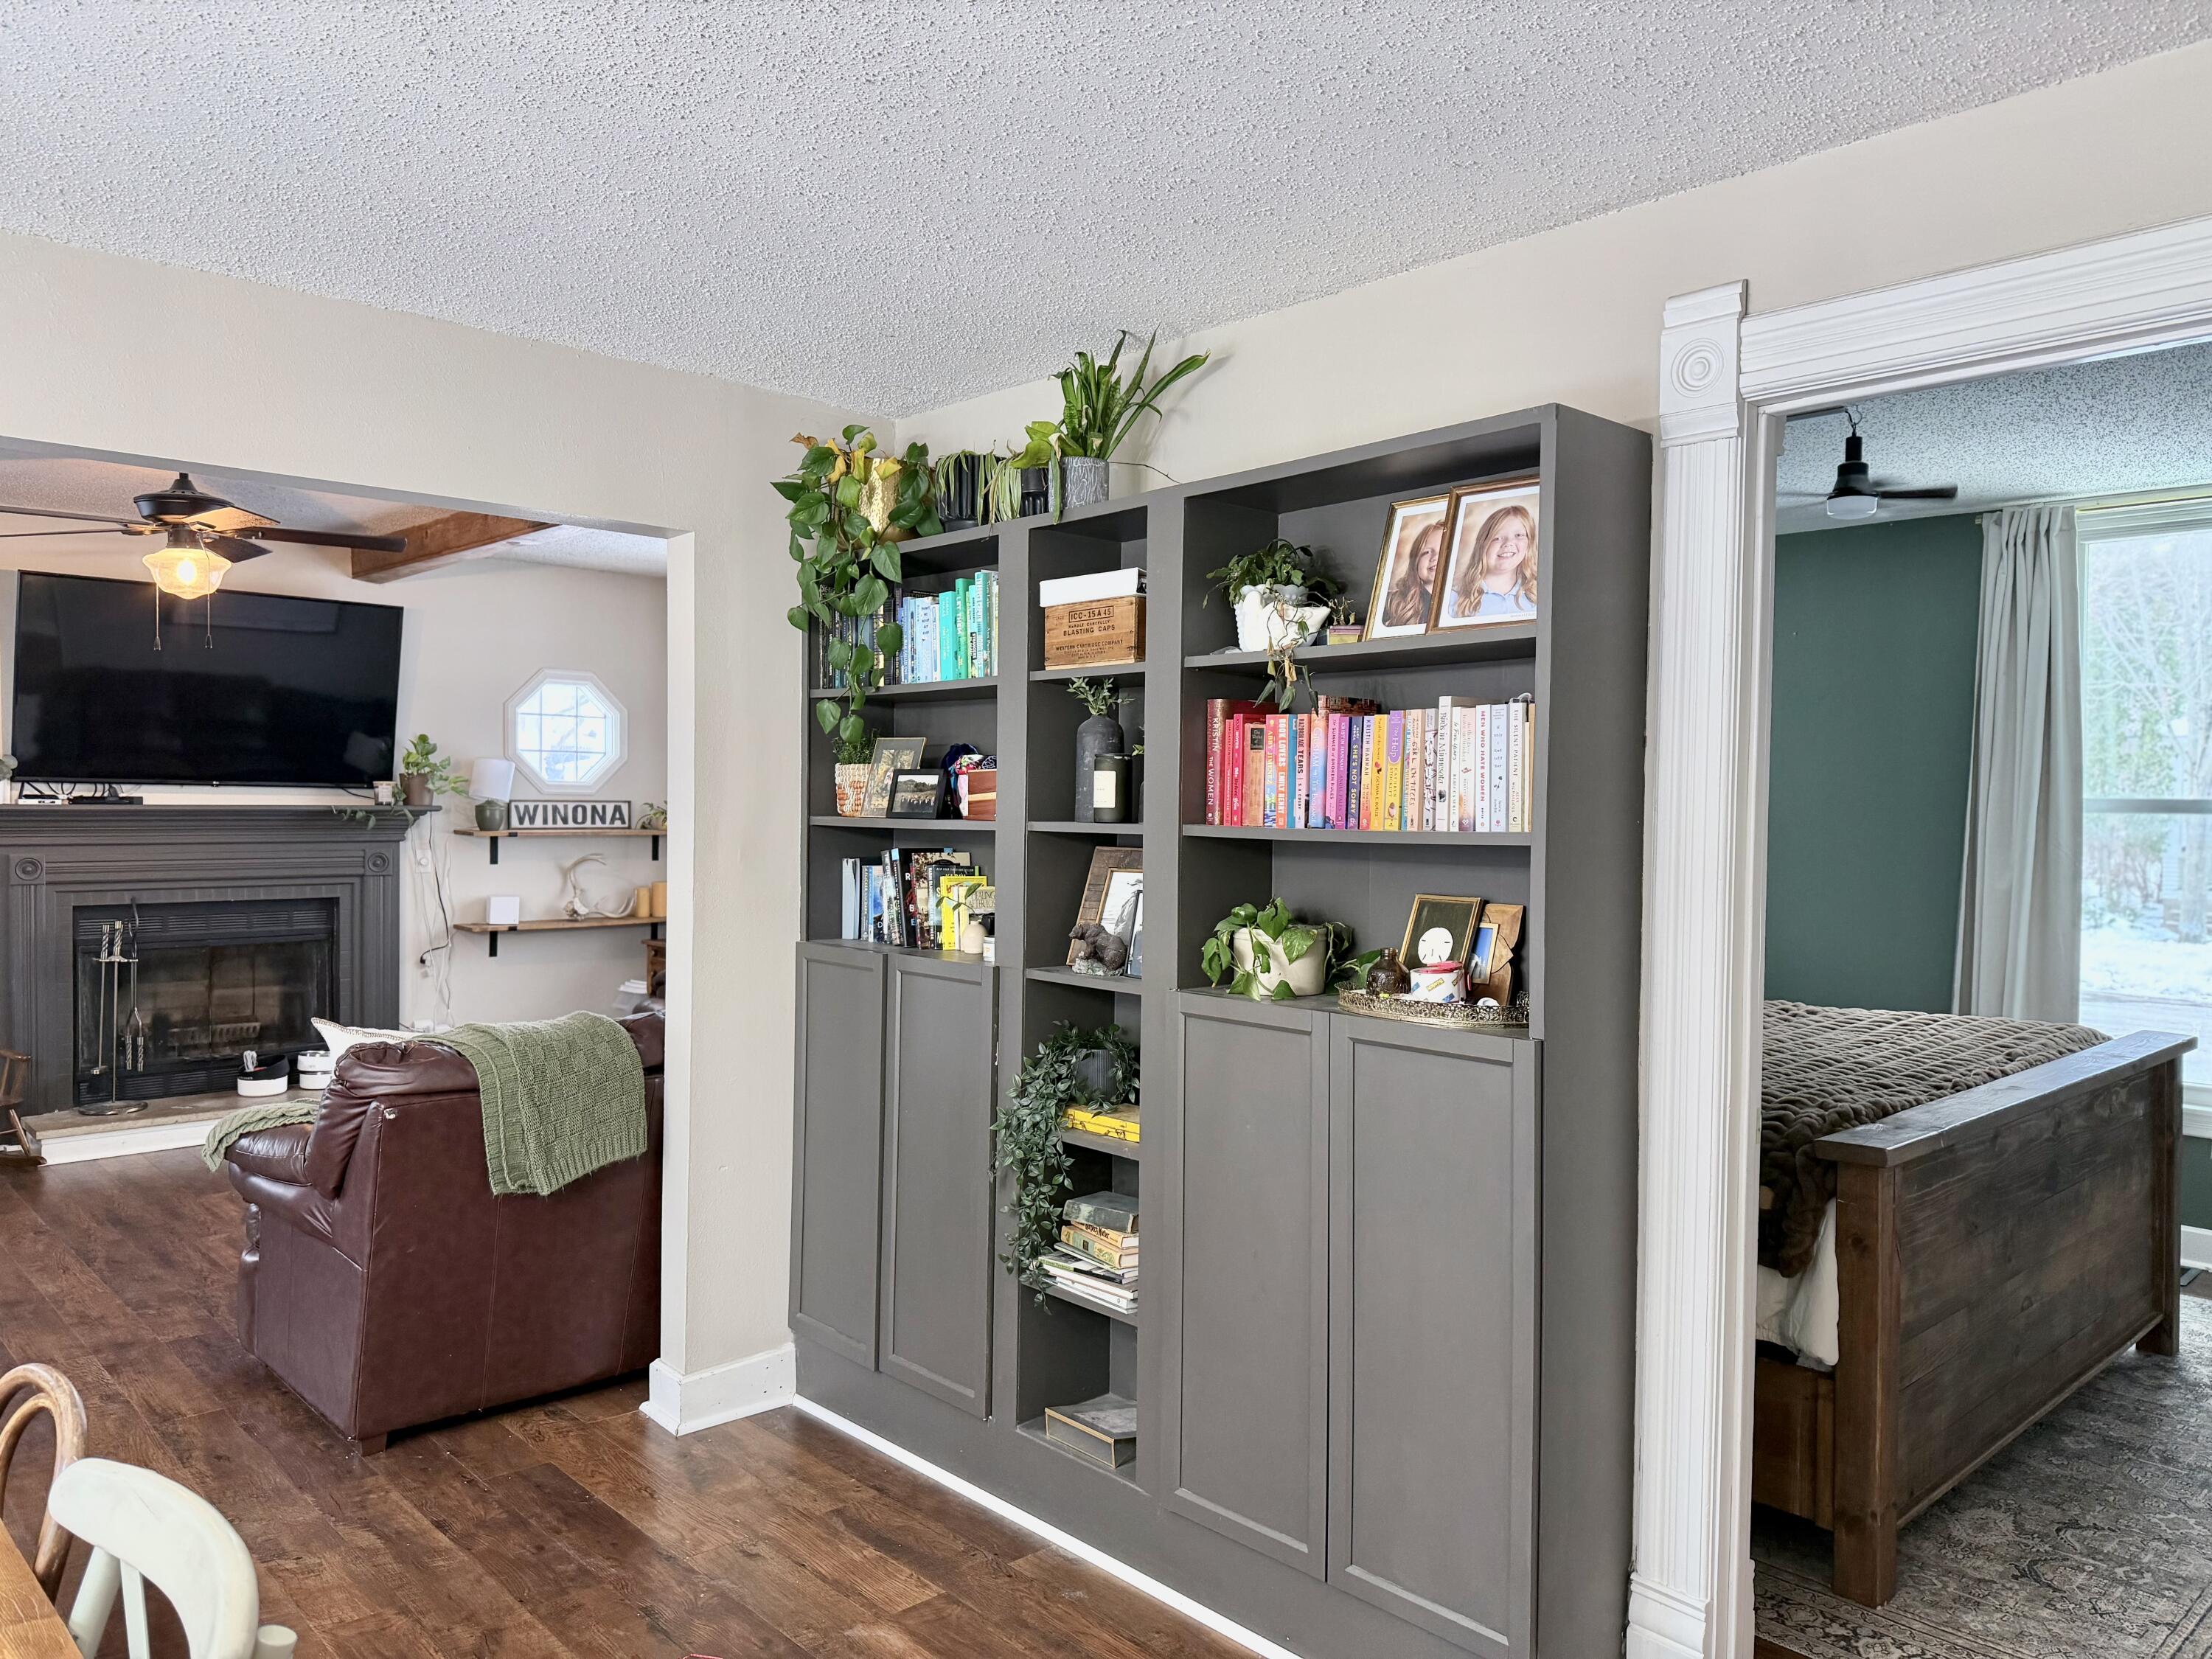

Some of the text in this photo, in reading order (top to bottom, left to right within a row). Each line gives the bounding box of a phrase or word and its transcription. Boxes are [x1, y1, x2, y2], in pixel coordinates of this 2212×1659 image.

[1063, 627, 1094, 636] BLASTING
[1439, 712, 1448, 730] Birds
[1312, 727, 1321, 767] GRISHAM
[1390, 737, 1399, 758] Help
[1411, 768, 1416, 778] IN
[1437, 743, 1447, 785] Minnesota
[1278, 772, 1286, 790] EMILY
[514, 804, 626, 825] WINONA
